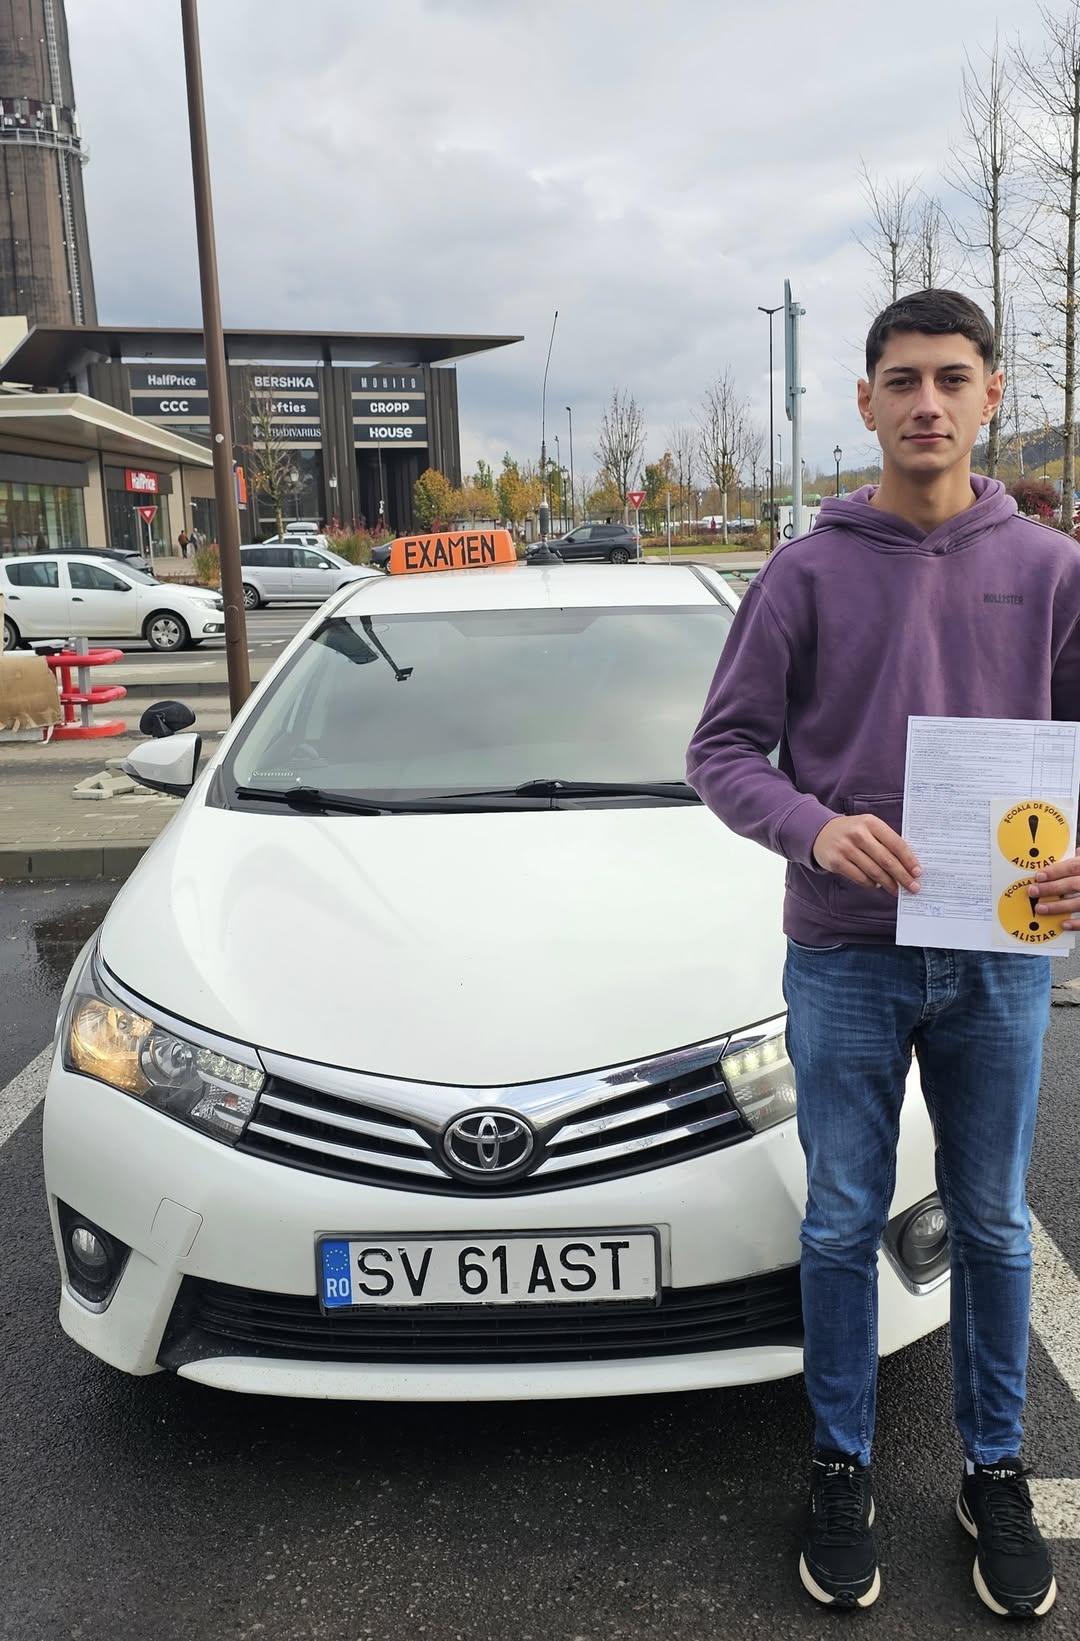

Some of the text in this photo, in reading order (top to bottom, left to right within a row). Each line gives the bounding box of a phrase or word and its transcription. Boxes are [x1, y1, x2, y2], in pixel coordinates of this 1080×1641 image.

[147, 374, 197, 386] HalfPrice
[254, 376, 314, 388] BERSHKA
[361, 377, 416, 389] MOHITO
[159, 400, 189, 413] CCC
[370, 402, 410, 413] CROPP
[404, 534, 496, 569] EXAMEN
[1012, 855, 1057, 870] ALISTAR
[1012, 929, 1057, 943] ALISTAR
[357, 1241, 630, 1297] SV 61 AST
[326, 1277, 350, 1298] RO
